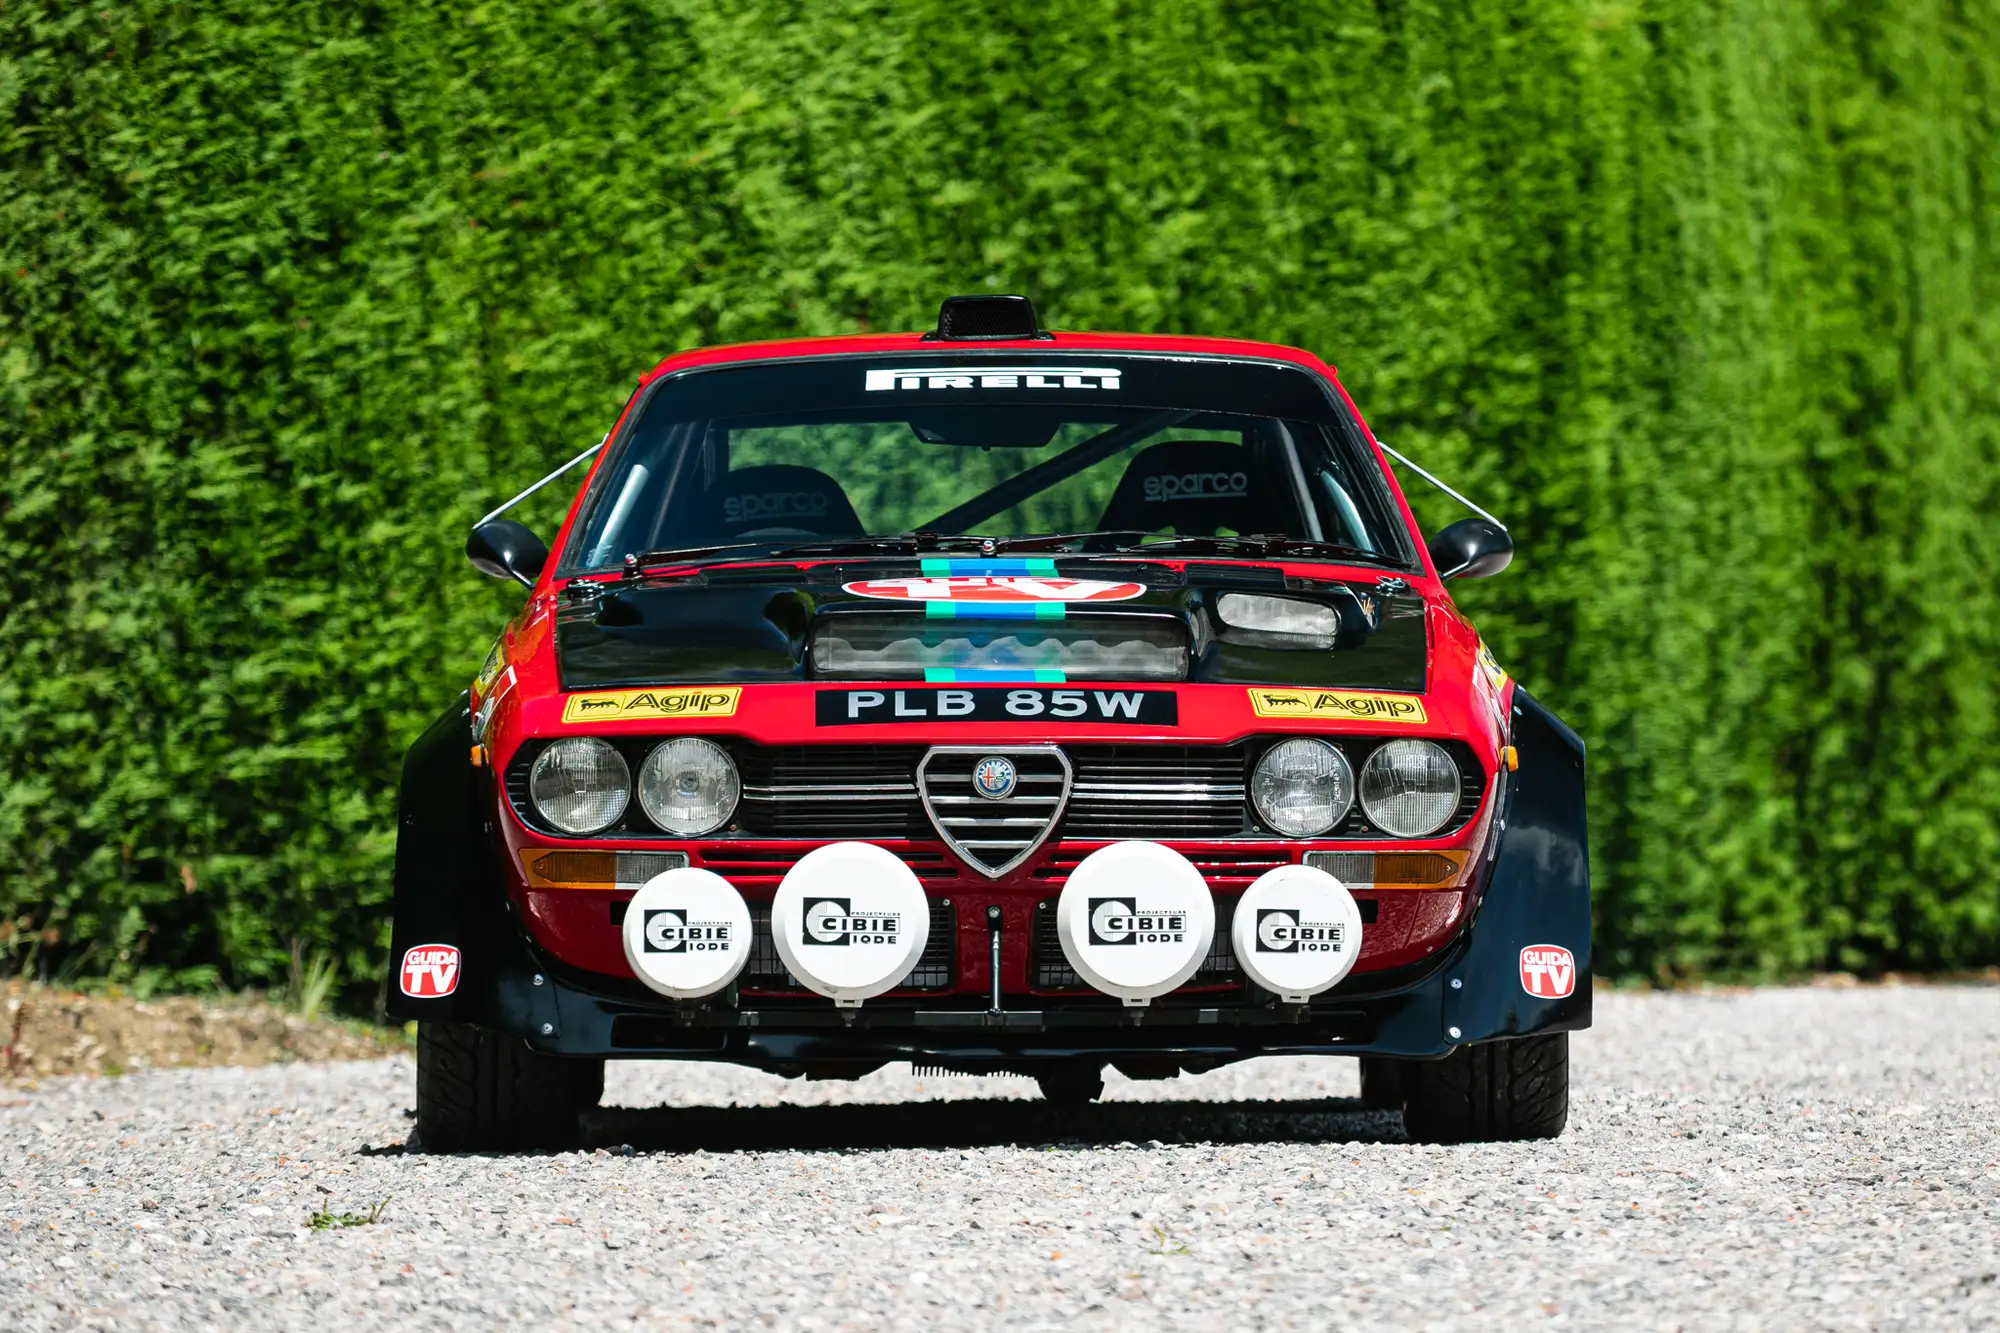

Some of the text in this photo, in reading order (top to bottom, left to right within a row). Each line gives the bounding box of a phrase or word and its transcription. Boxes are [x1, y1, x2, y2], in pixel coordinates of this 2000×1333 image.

[865, 366, 1122, 391] PIRELLI
[1143, 471, 1248, 502] sparco
[723, 491, 828, 523] sparco
[624, 691, 730, 713] Agip
[847, 690, 1145, 718] PLB 85W
[1313, 693, 1415, 717] Agip
[689, 943, 729, 951] IODE
[853, 935, 896, 944] IODE
[1139, 934, 1183, 943] IODE
[1302, 943, 1341, 952] IODE
[407, 951, 458, 965] GUIDA
[1523, 950, 1572, 967] GUIDA
[405, 965, 458, 993] TV
[1523, 964, 1572, 994] TV
